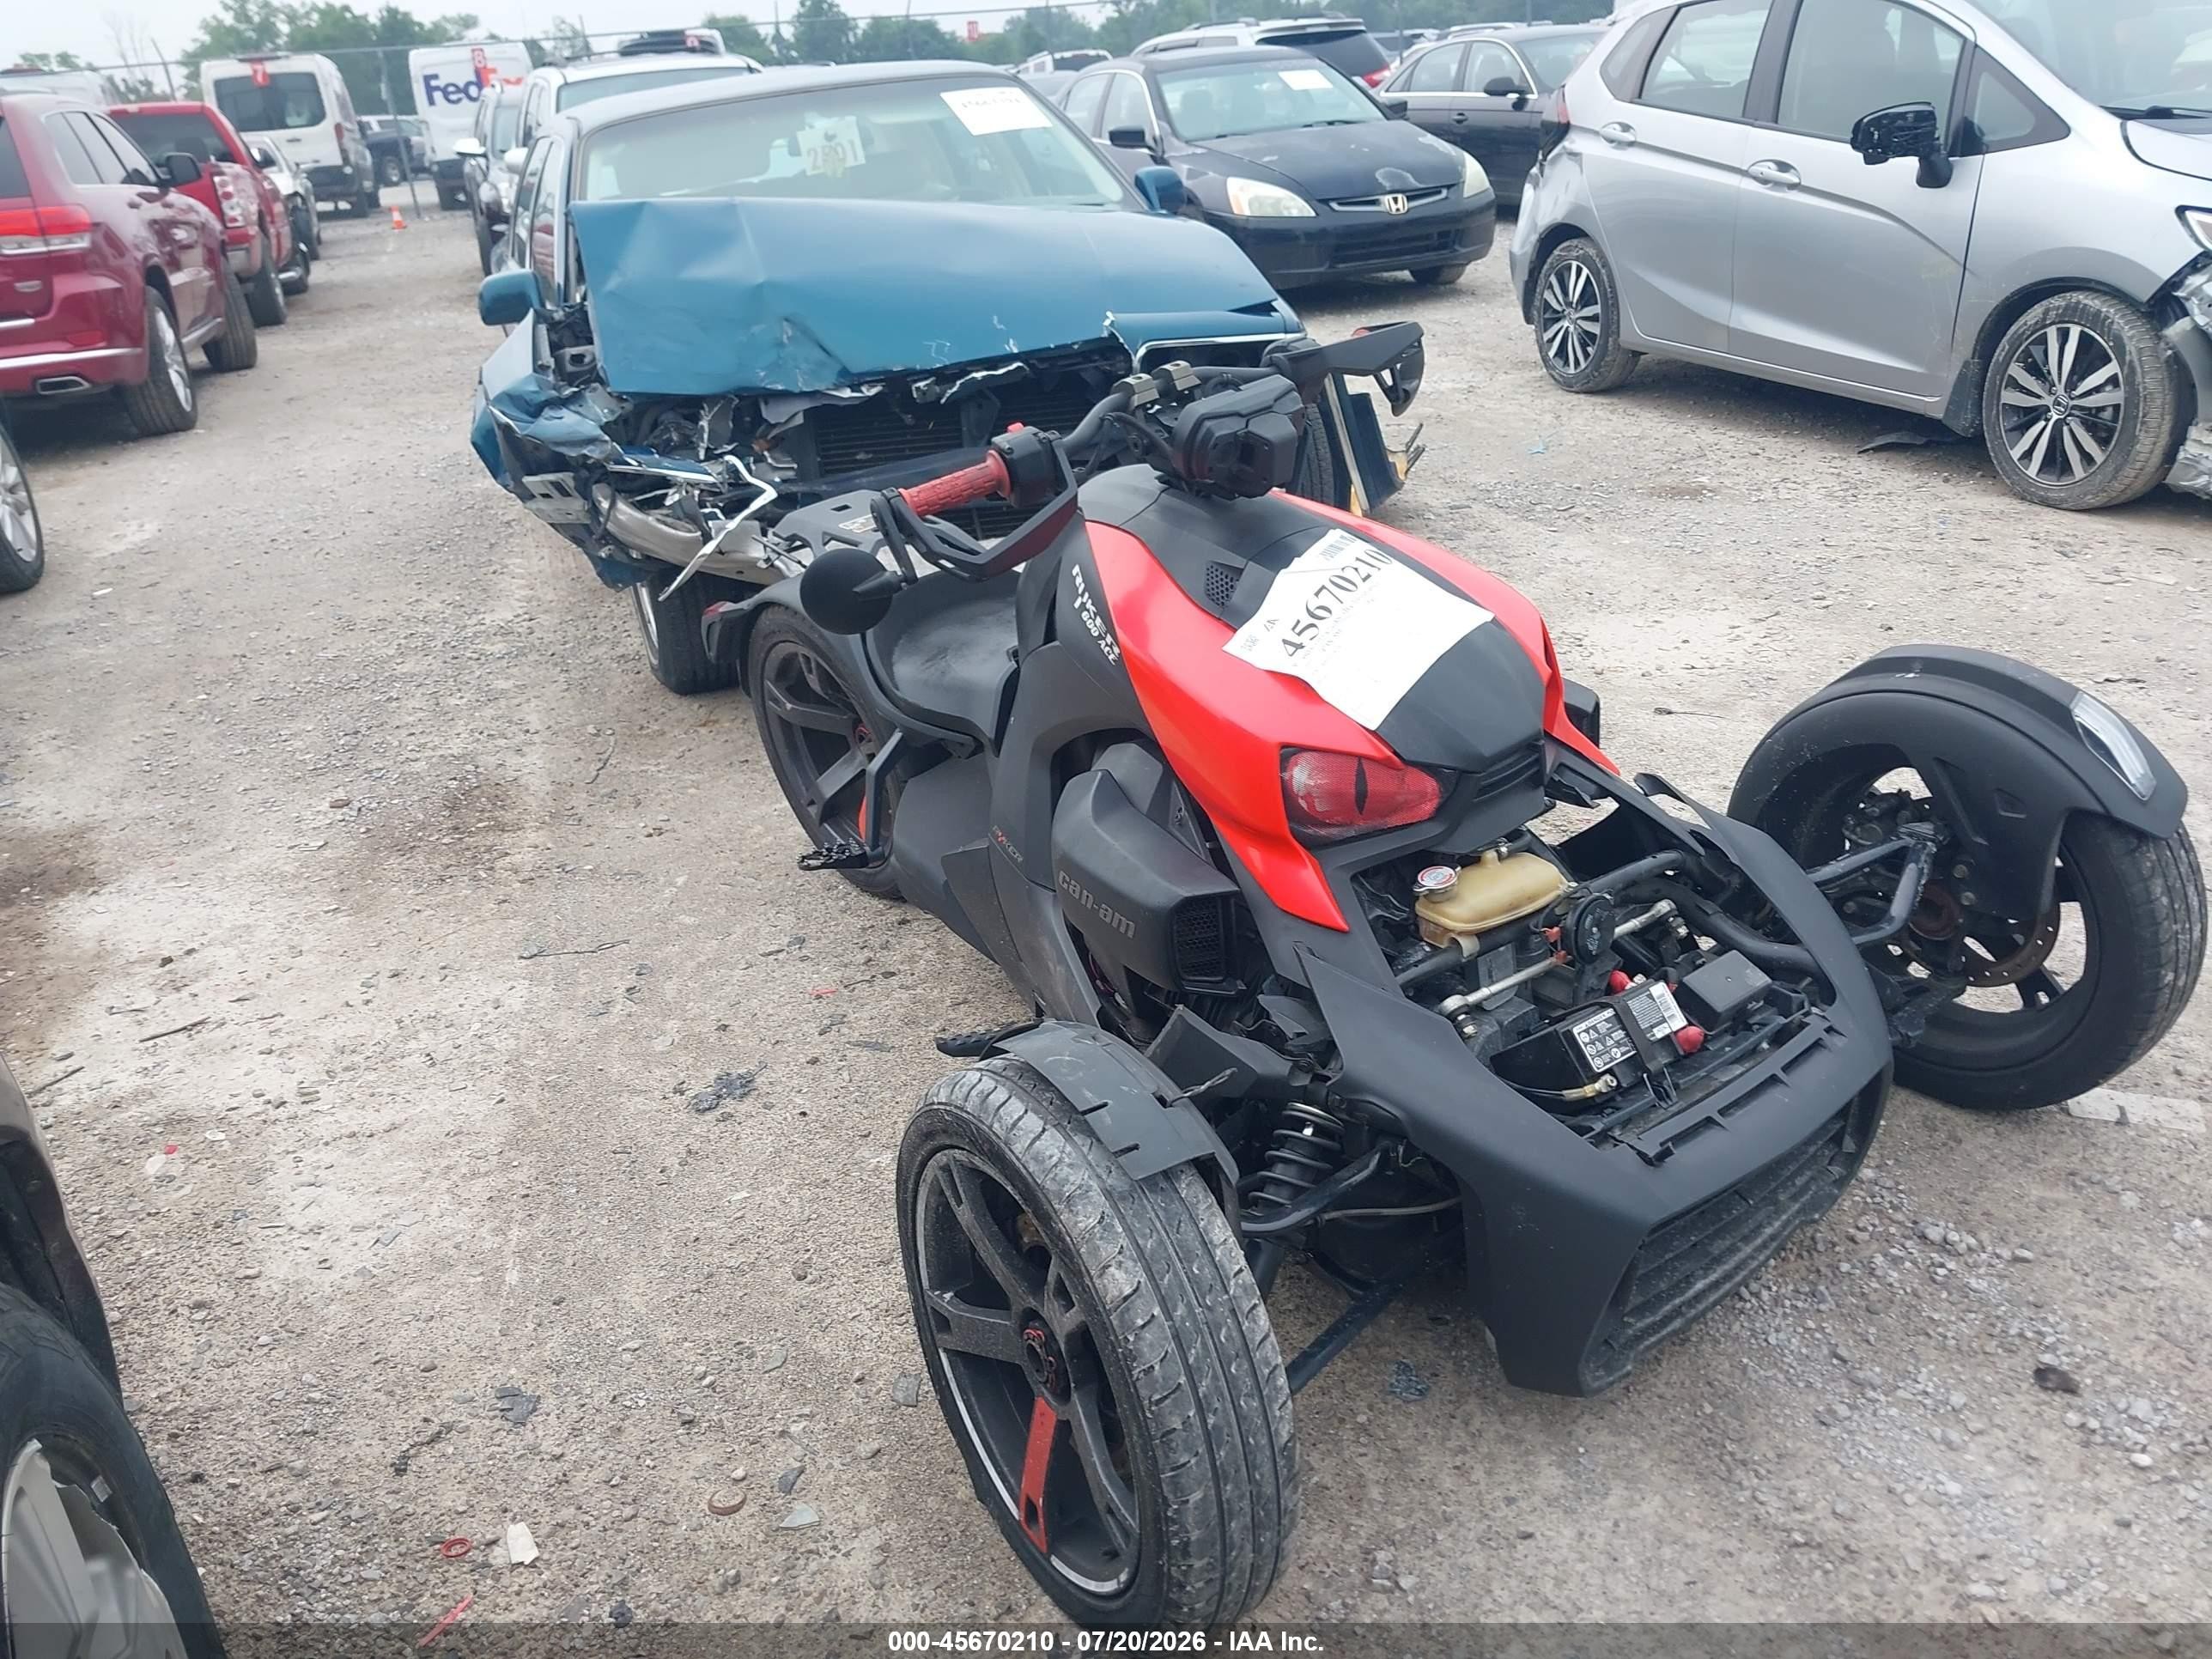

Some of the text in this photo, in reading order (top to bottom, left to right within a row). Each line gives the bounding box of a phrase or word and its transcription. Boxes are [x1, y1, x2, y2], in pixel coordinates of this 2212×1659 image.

[422, 68, 523, 106] FedE
[1282, 549, 1393, 657] 45670210
[1081, 611, 1118, 665] 600 ACE
[1058, 870, 1136, 939] can-am
